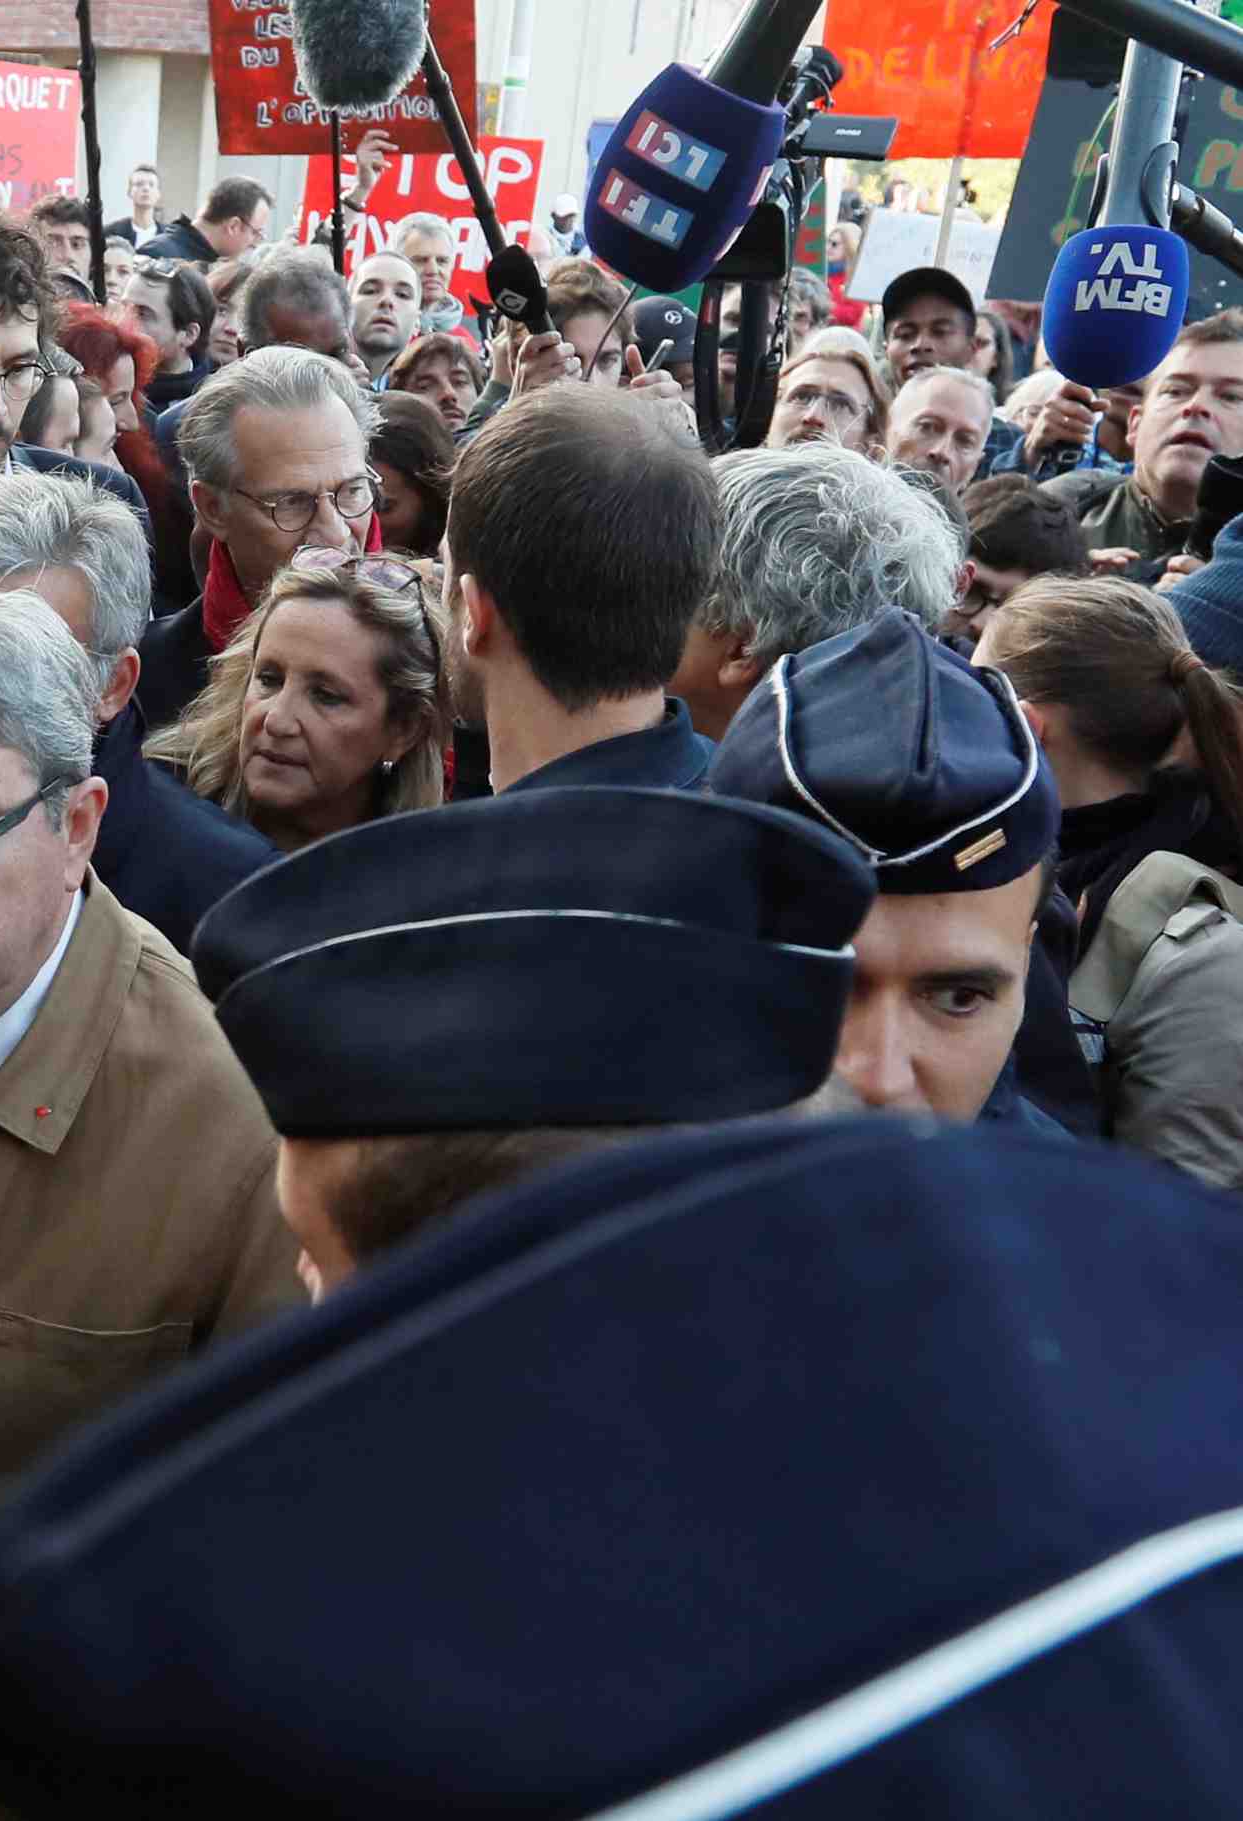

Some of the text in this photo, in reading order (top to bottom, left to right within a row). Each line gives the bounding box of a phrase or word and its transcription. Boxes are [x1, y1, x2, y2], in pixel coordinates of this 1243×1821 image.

[241, 46, 280, 68] DU
[637, 121, 709, 180] LCI
[1075, 278, 1173, 318] BFM
